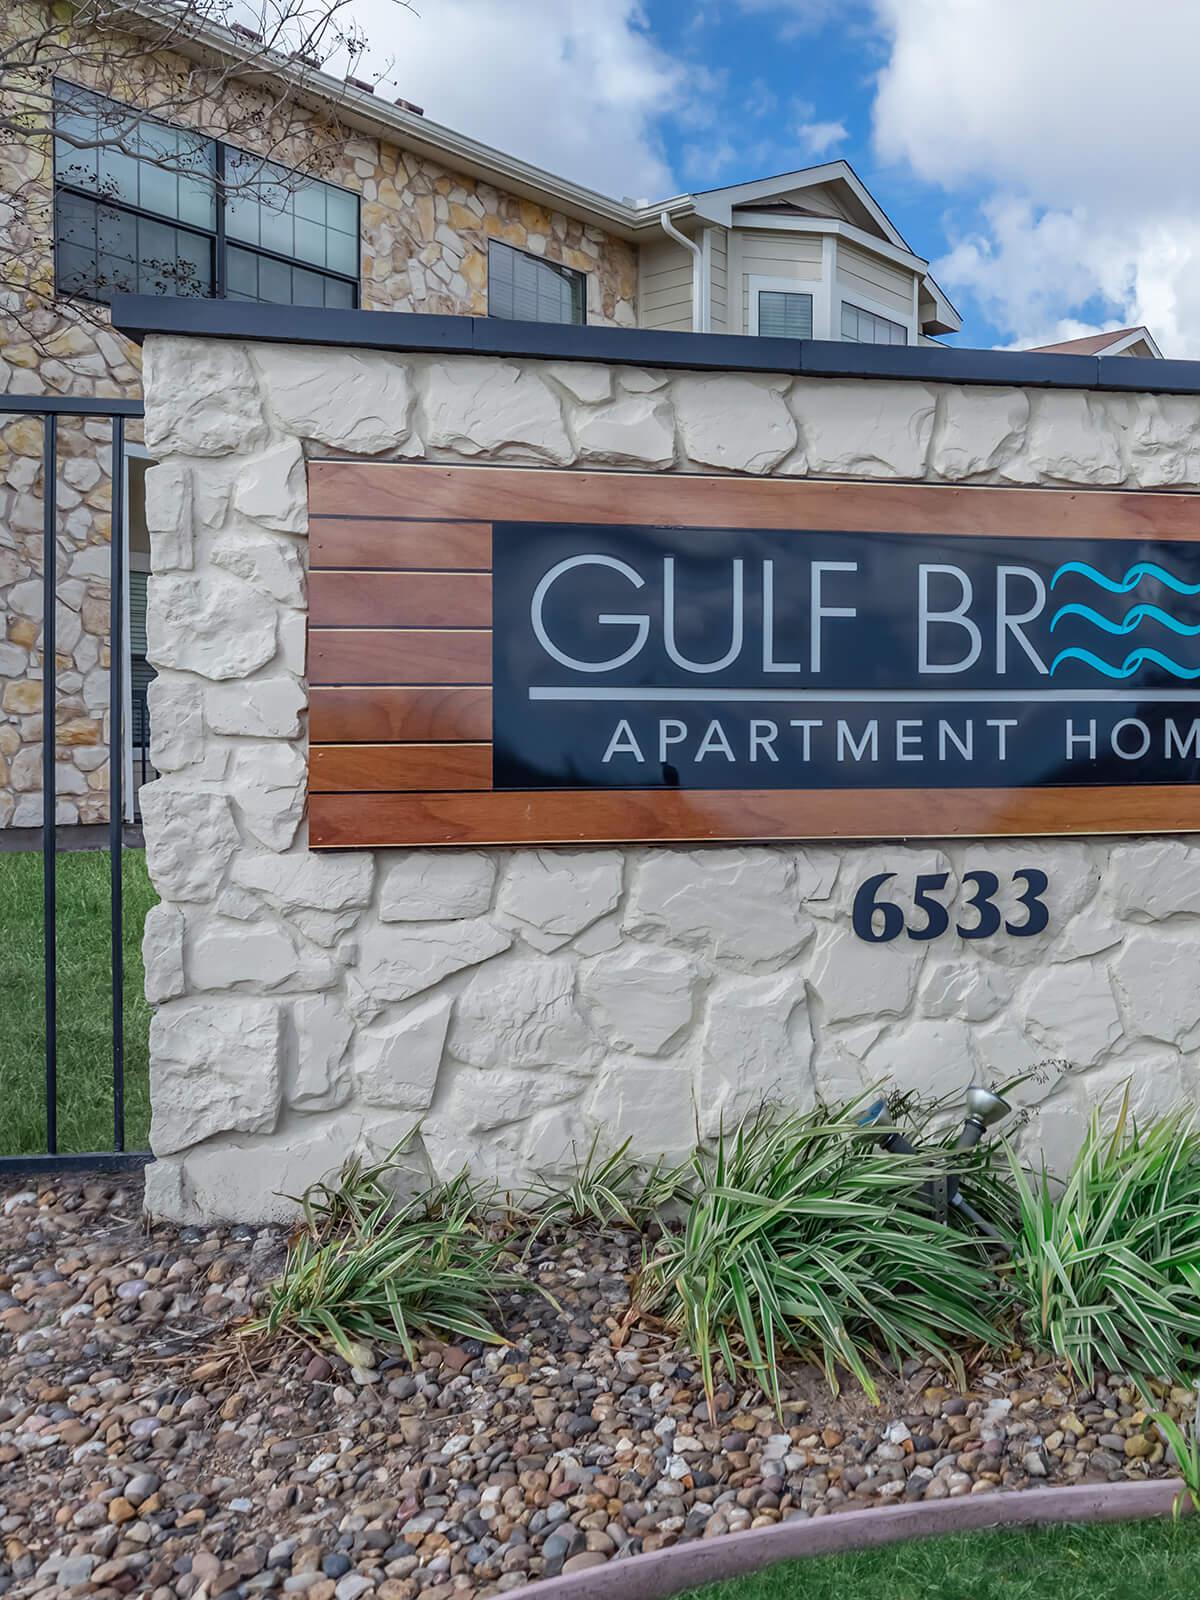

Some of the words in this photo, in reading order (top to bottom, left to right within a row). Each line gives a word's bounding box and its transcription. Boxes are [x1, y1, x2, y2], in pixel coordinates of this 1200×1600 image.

[530, 553, 858, 674] GULF
[601, 719, 1018, 763] APARTMENT
[852, 868, 1050, 943] 6533
